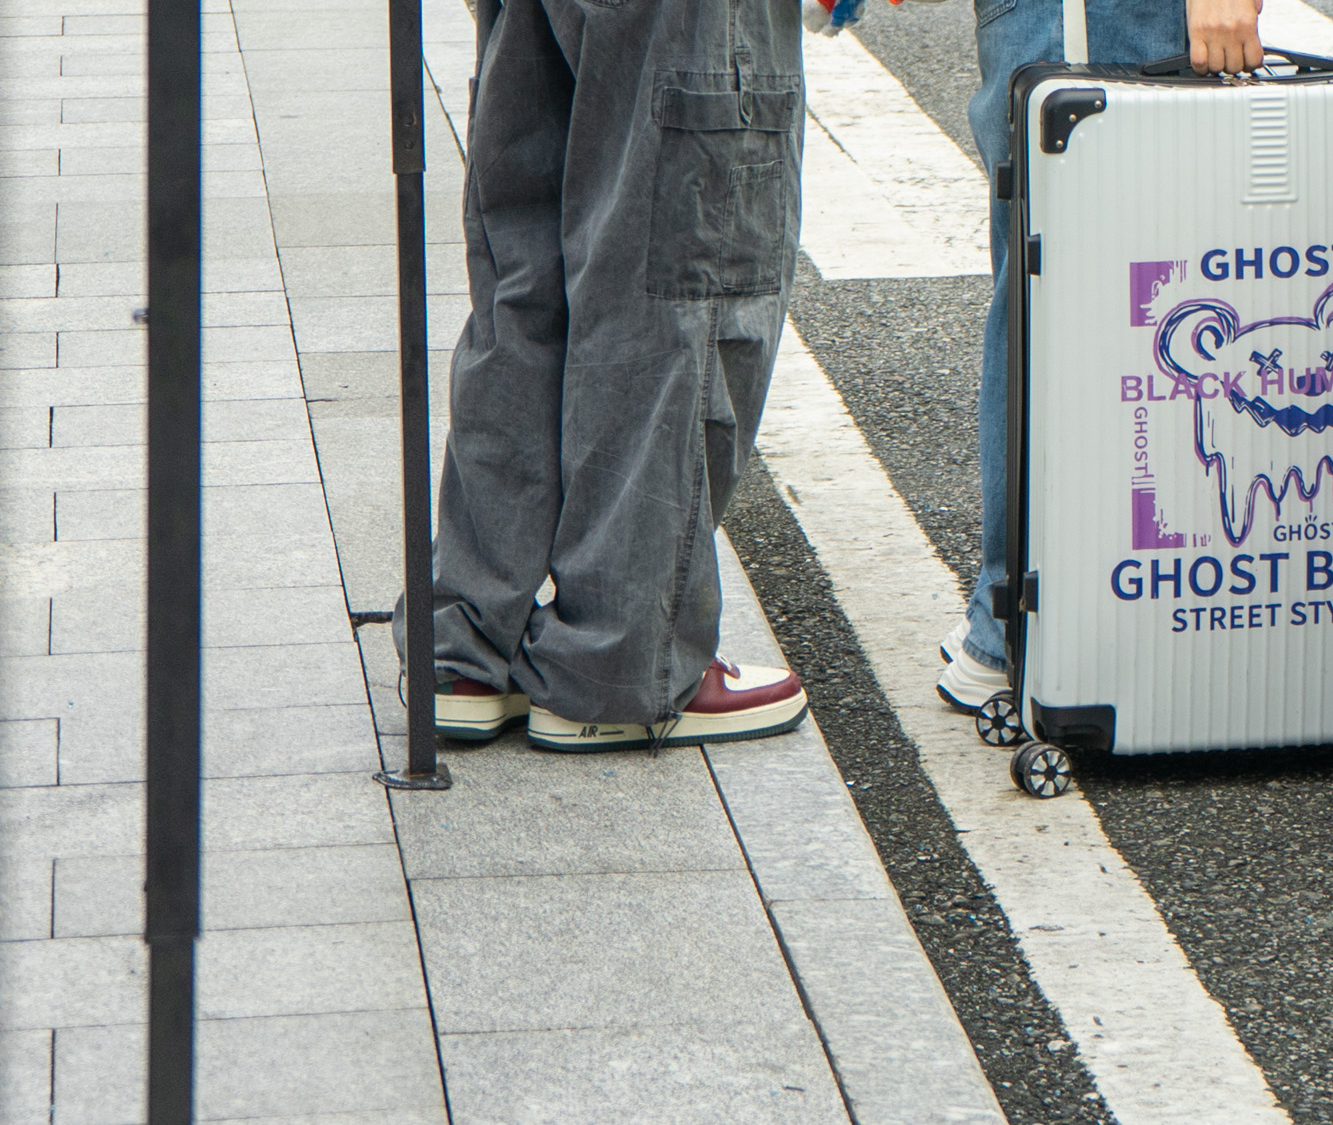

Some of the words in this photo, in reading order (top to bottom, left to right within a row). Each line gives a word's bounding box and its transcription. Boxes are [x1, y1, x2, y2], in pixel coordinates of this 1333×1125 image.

[1120, 370, 1248, 403] BLACK
[1133, 406, 1149, 475] GHOST
[1110, 552, 1290, 601] GHOST
[1171, 603, 1282, 633] STREET
[578, 726, 599, 739] AIR
